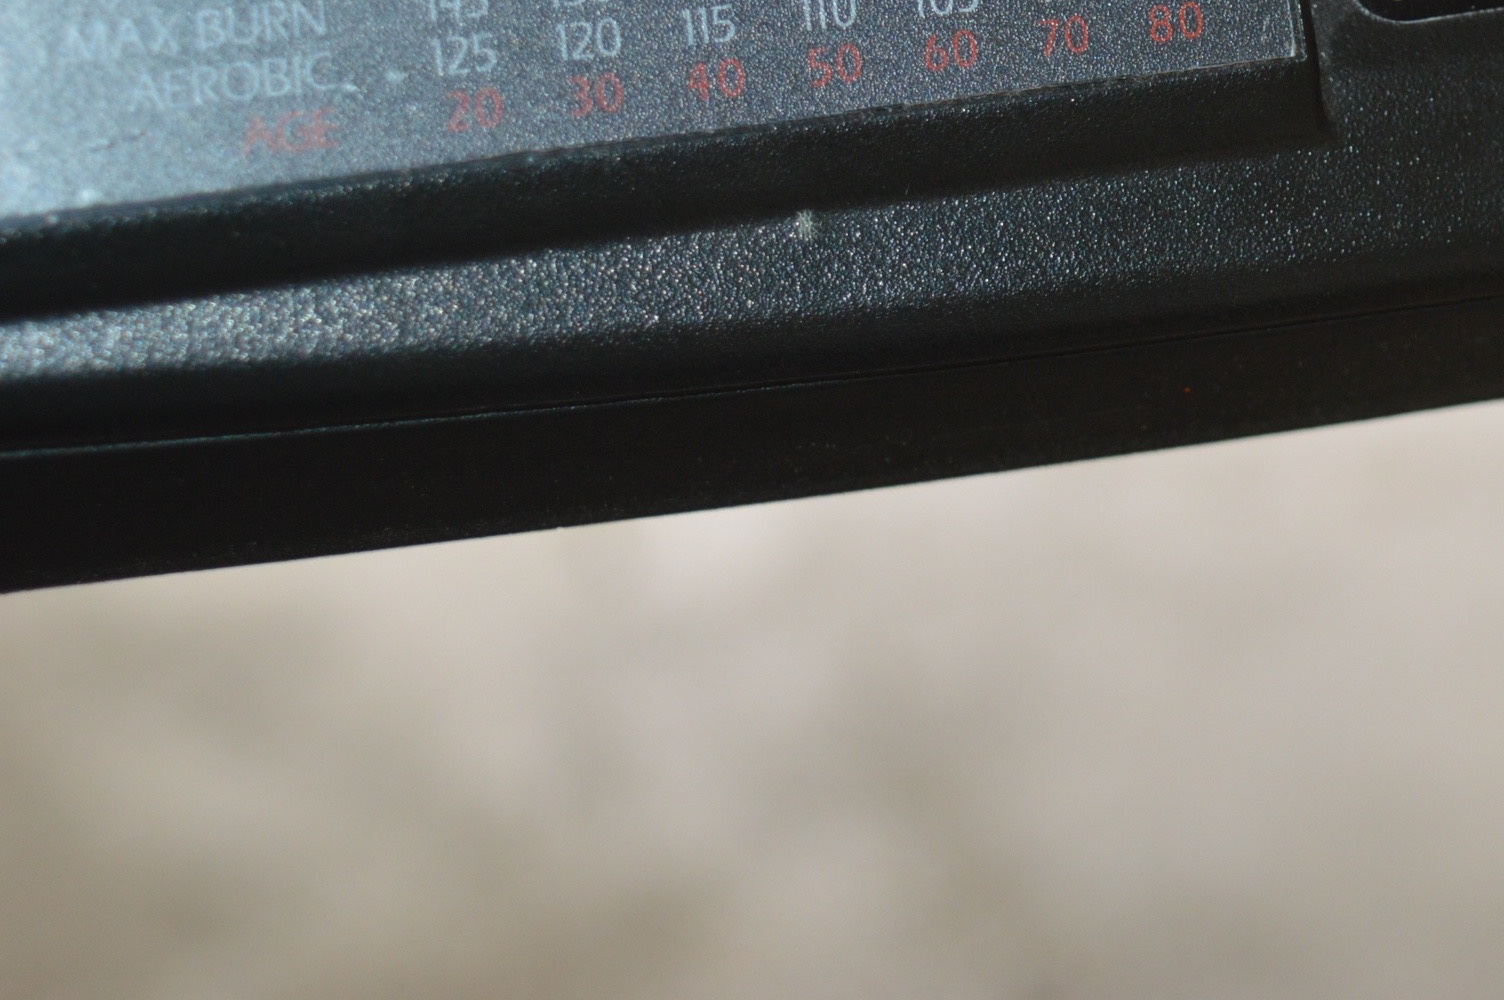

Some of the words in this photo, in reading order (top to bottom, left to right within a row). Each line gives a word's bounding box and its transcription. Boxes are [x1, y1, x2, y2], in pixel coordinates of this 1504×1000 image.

[58, 11, 181, 60] MAX
[197, 0, 328, 50] BURN
[133, 51, 345, 106] AEROBIC
[432, 33, 499, 76] 125
[556, 18, 623, 61] 120
[684, 3, 737, 45] 115
[244, 107, 340, 156] AGE
[446, 88, 503, 132] 20
[568, 74, 624, 118] 30
[687, 58, 746, 101] 40
[806, 43, 863, 89] 50
[925, 29, 978, 72] 60
[1038, 14, 1090, 58] 70
[1148, 0, 1204, 44] 80
